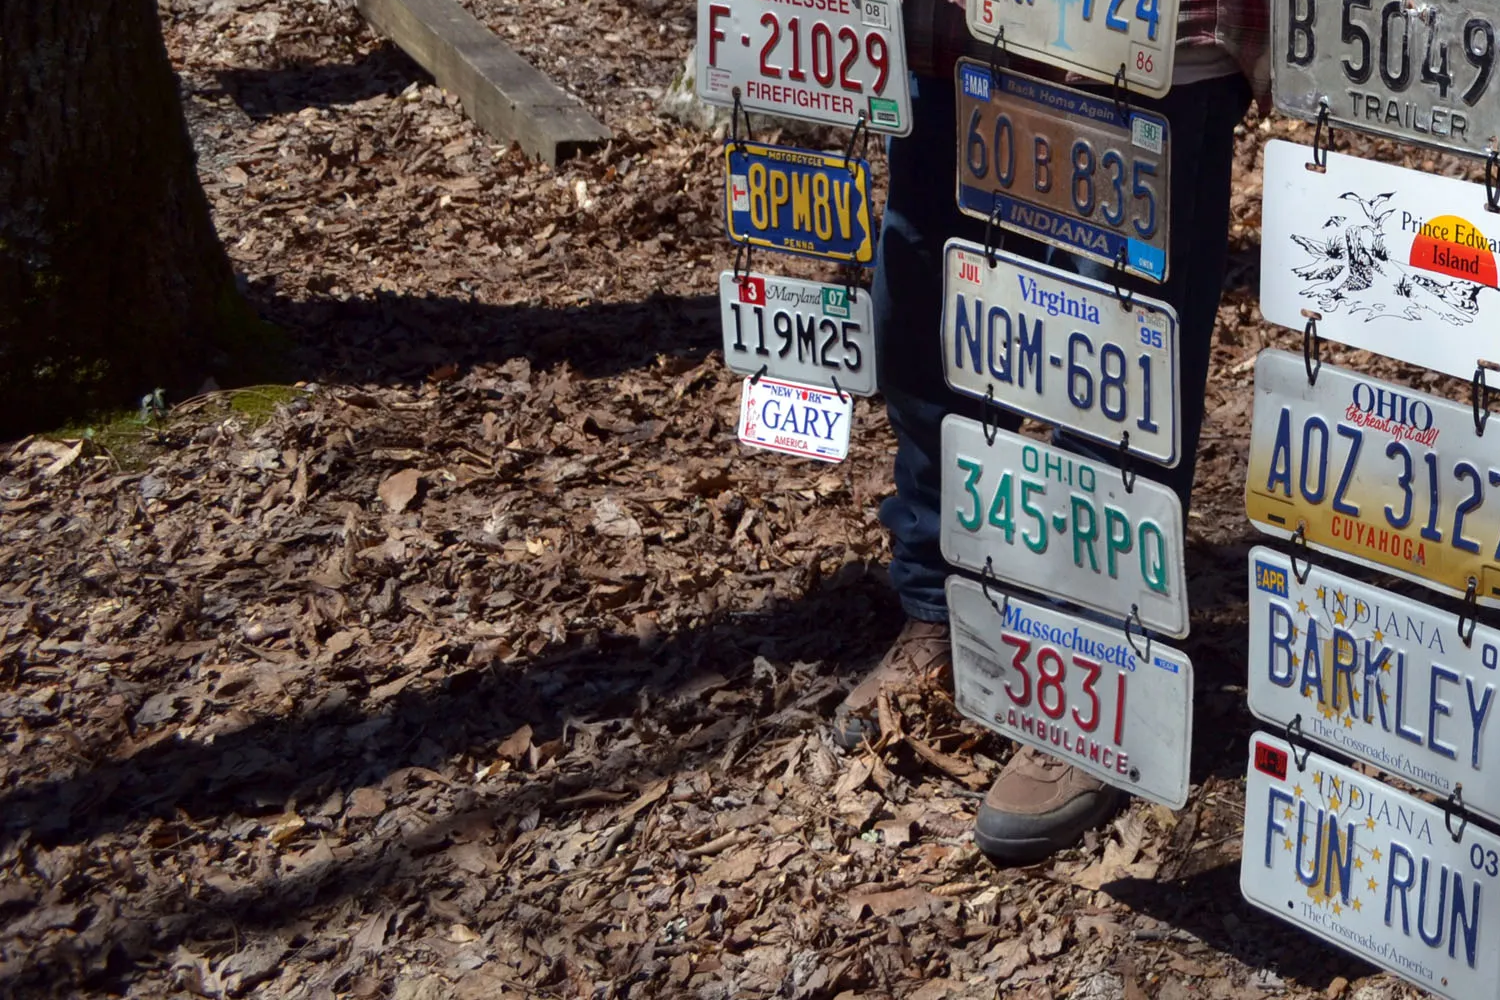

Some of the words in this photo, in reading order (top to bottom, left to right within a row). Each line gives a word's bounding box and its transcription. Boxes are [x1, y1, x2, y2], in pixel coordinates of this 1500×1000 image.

[747, 81, 854, 114] FIREFIGHTER
[970, 74, 989, 99] MAR
[1349, 91, 1468, 142] TRAILER
[768, 152, 823, 167] MOTORCYCLE
[966, 107, 1014, 189] 60
[1034, 136, 1051, 193] B
[1071, 139, 1158, 239] 835
[748, 163, 850, 241] 8PM8V
[1402, 211, 1449, 242] Prince
[784, 238, 814, 250] PENNA
[1010, 205, 1109, 253] INDIANA
[959, 262, 980, 284] JUL
[1432, 245, 1479, 275] Island
[765, 286, 822, 308] Maryland
[1017, 274, 1100, 325] Virginia
[731, 303, 861, 371] 119M25
[1140, 327, 1163, 349] 95
[955, 293, 1158, 433] NQM-681
[762, 400, 842, 440] GARY
[1345, 402, 1363, 427] the
[1365, 410, 1390, 433] heart
[1392, 424, 1405, 442] of
[1353, 382, 1433, 431] OHIO
[774, 435, 808, 449] AMERICA
[1022, 446, 1096, 493] OHIO
[1332, 516, 1426, 566] CUYAHOGA
[1263, 568, 1284, 593] APR
[1002, 604, 1136, 672] Massachusetts
[1320, 585, 1446, 655] INDIANA
[1002, 634, 1126, 746] 3831
[1268, 602, 1495, 770] BARKLEY
[1007, 708, 1129, 774] AMBULANCE
[1310, 717, 1332, 737] The
[1333, 728, 1390, 762] Crossroads
[1391, 753, 1403, 770] of
[1403, 760, 1449, 789] America
[1319, 771, 1432, 845] INDIANA
[1265, 786, 1355, 906] FUN
[1384, 841, 1481, 970] RUN
[1301, 902, 1322, 920] The
[1322, 914, 1376, 950] Crossroads
[1389, 948, 1433, 980] America
